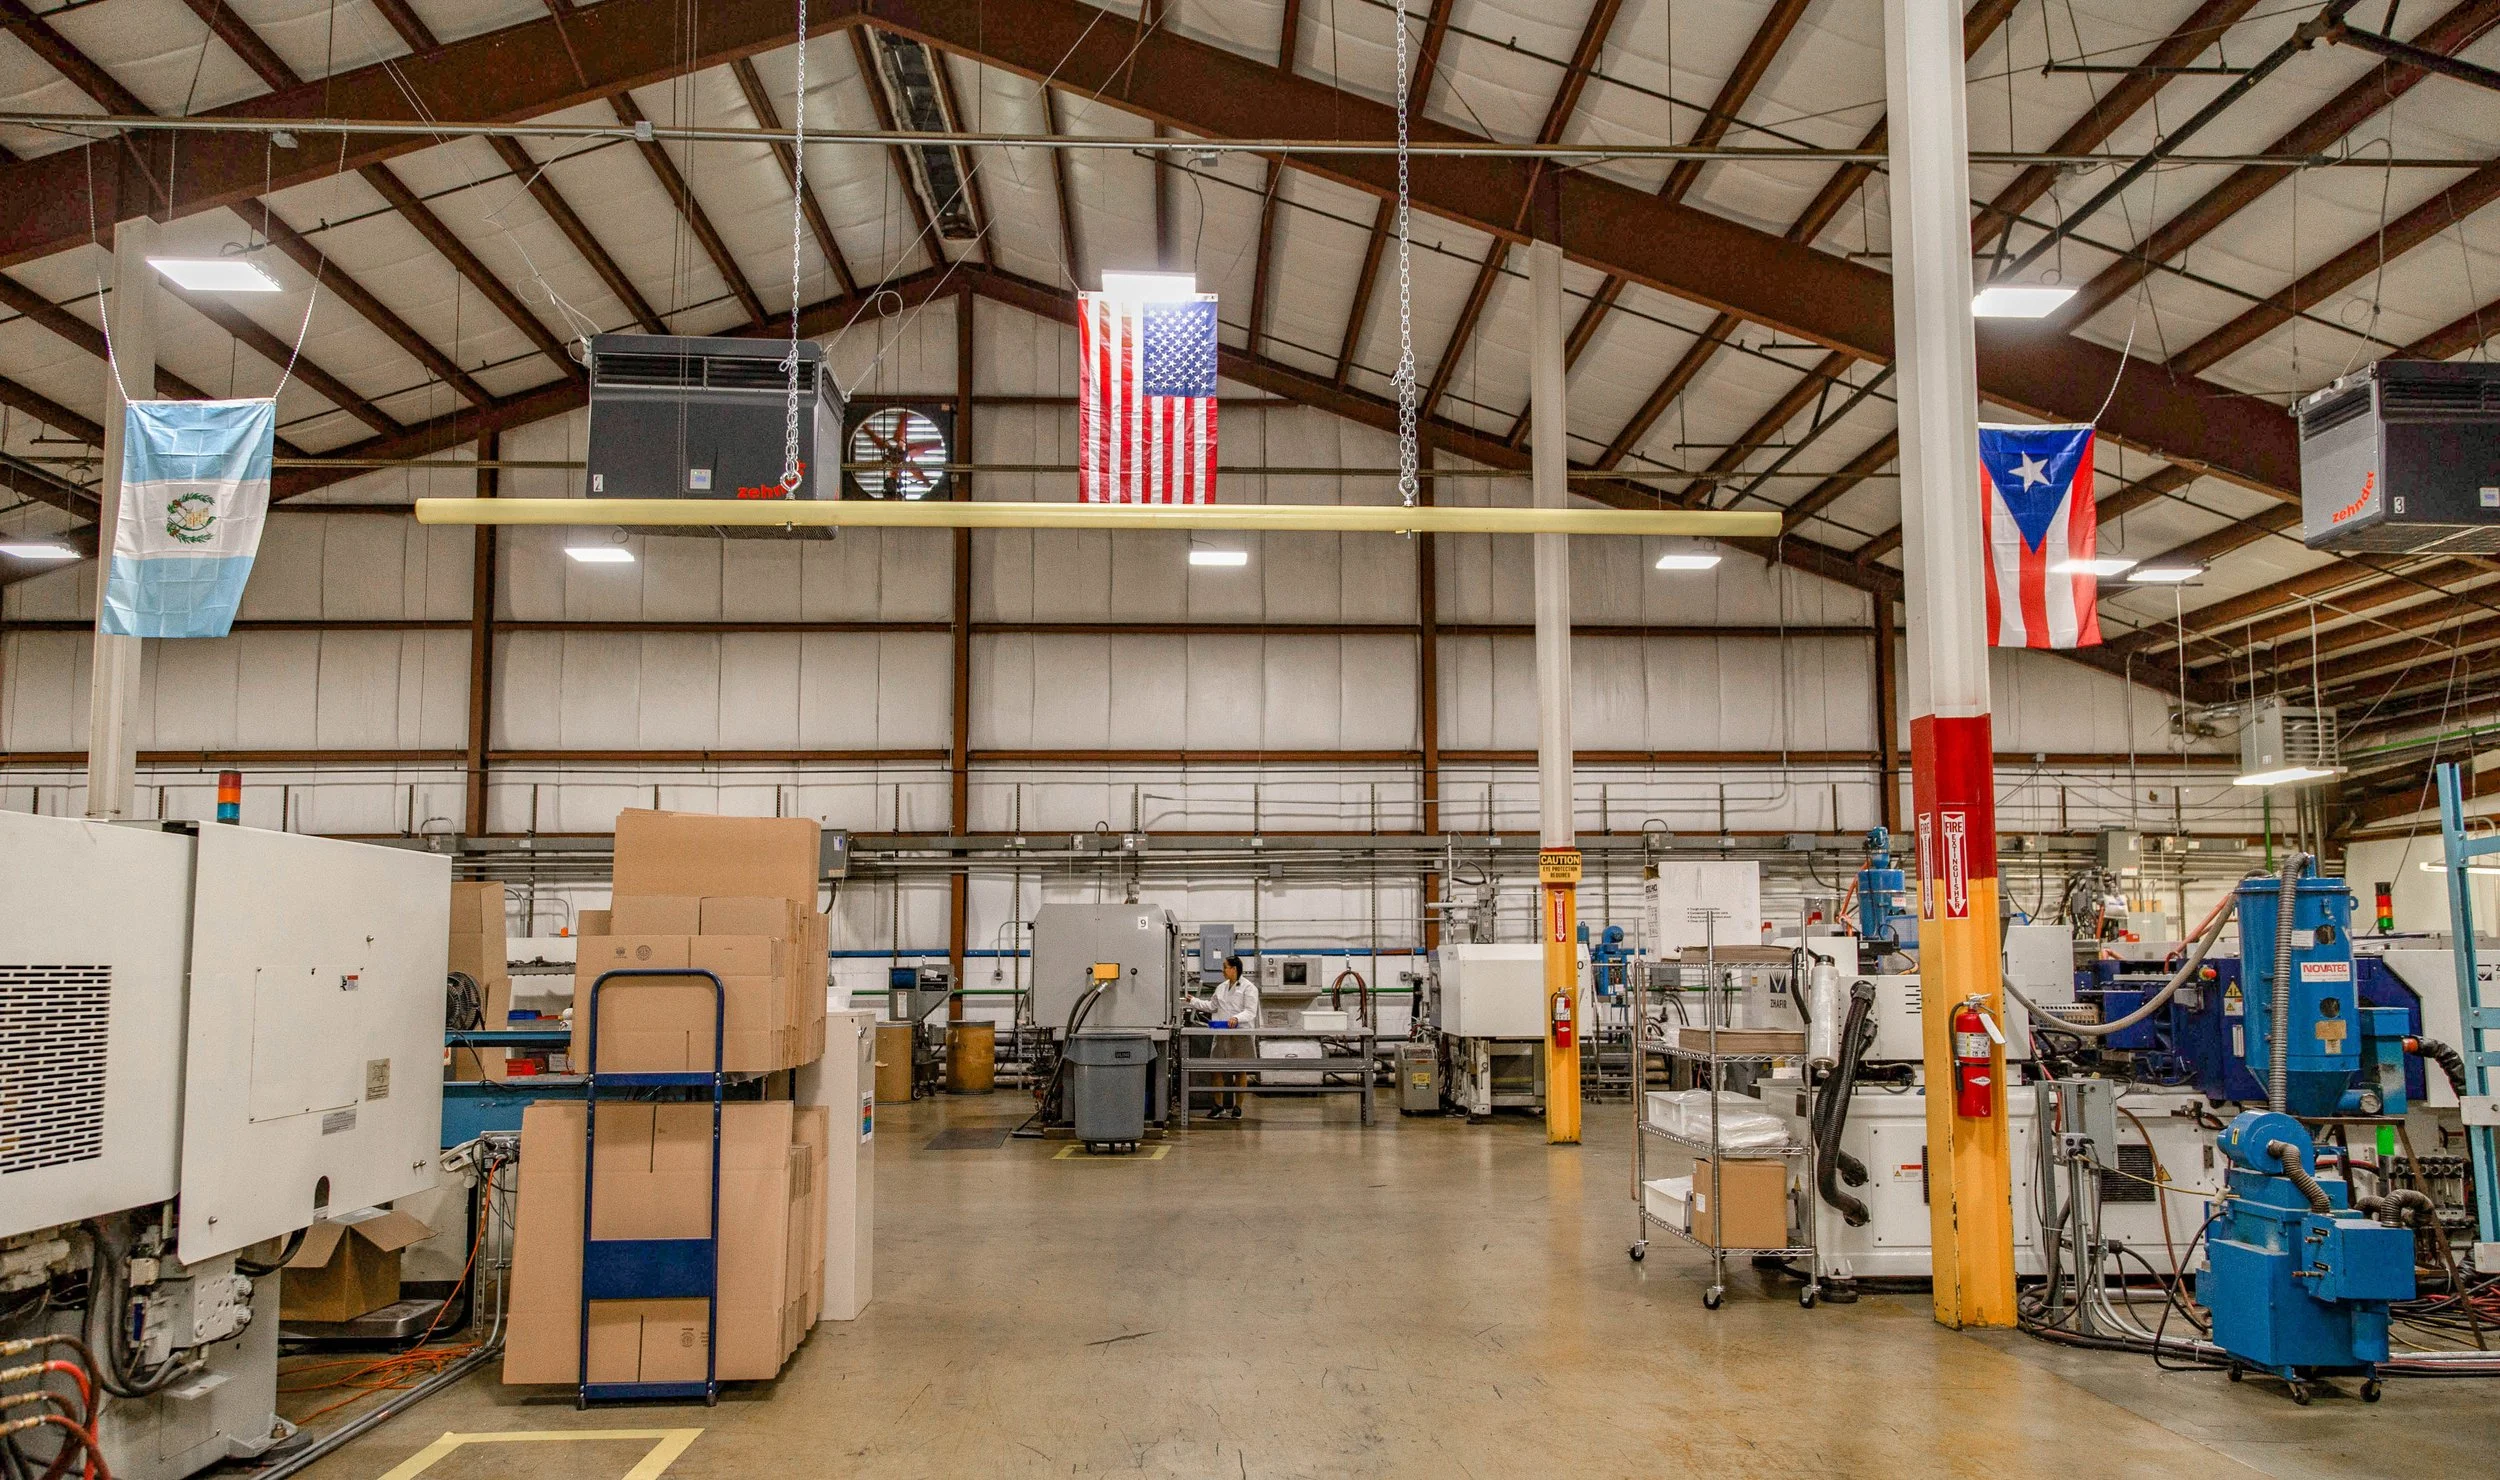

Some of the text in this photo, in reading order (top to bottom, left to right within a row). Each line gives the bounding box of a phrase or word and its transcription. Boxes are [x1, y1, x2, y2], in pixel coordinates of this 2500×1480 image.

[2332, 471, 2375, 524] zehnder
[2396, 499, 2403, 513] 3
[1920, 822, 1930, 834] FIRE
[1945, 821, 1963, 833] FIRE
[1541, 856, 1580, 865] CAUTION
[1951, 833, 1961, 909] EXTINGUISHER
[1140, 919, 1147, 928] 9
[2302, 964, 2348, 973] NOVATEC
[1770, 999, 1788, 1009] ZHAFIR
